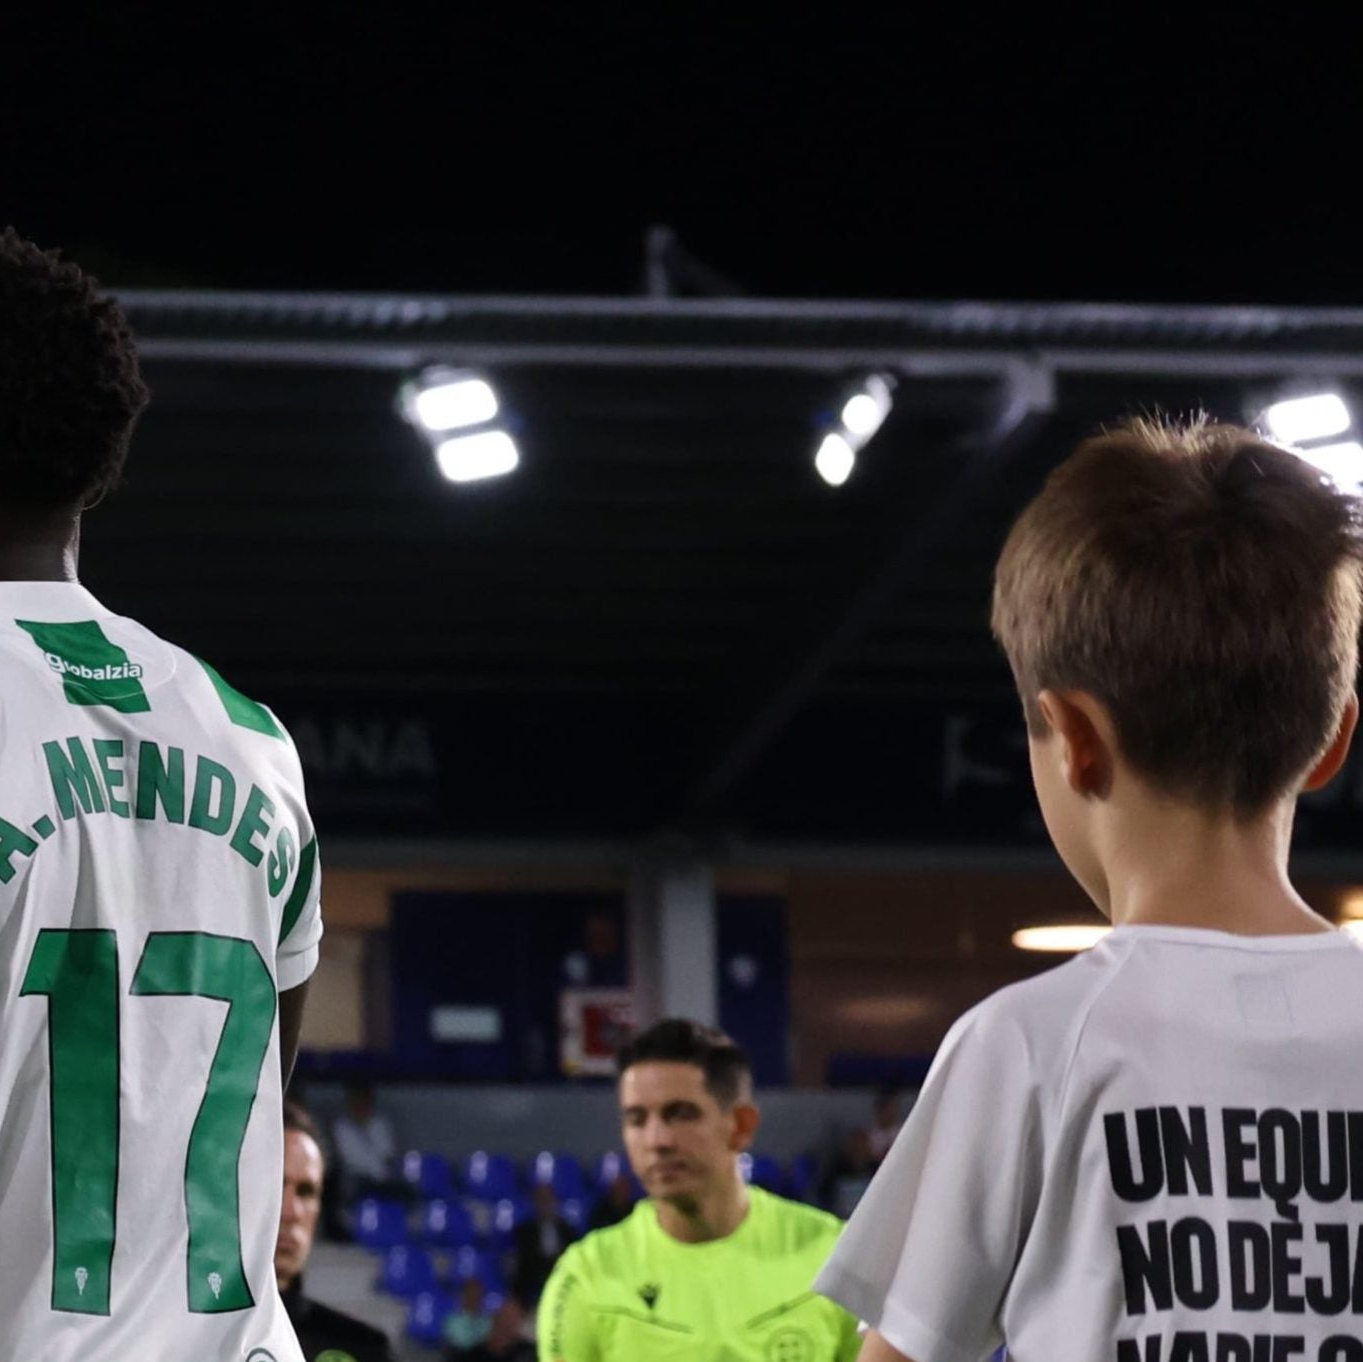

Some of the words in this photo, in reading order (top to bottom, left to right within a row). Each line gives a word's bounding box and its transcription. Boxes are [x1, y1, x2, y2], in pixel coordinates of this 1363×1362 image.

[18, 927, 277, 1316] 17
[1103, 1106, 1213, 1203] UN
[1116, 1215, 1220, 1317] NO
[1227, 1220, 1363, 1316] DEJ
